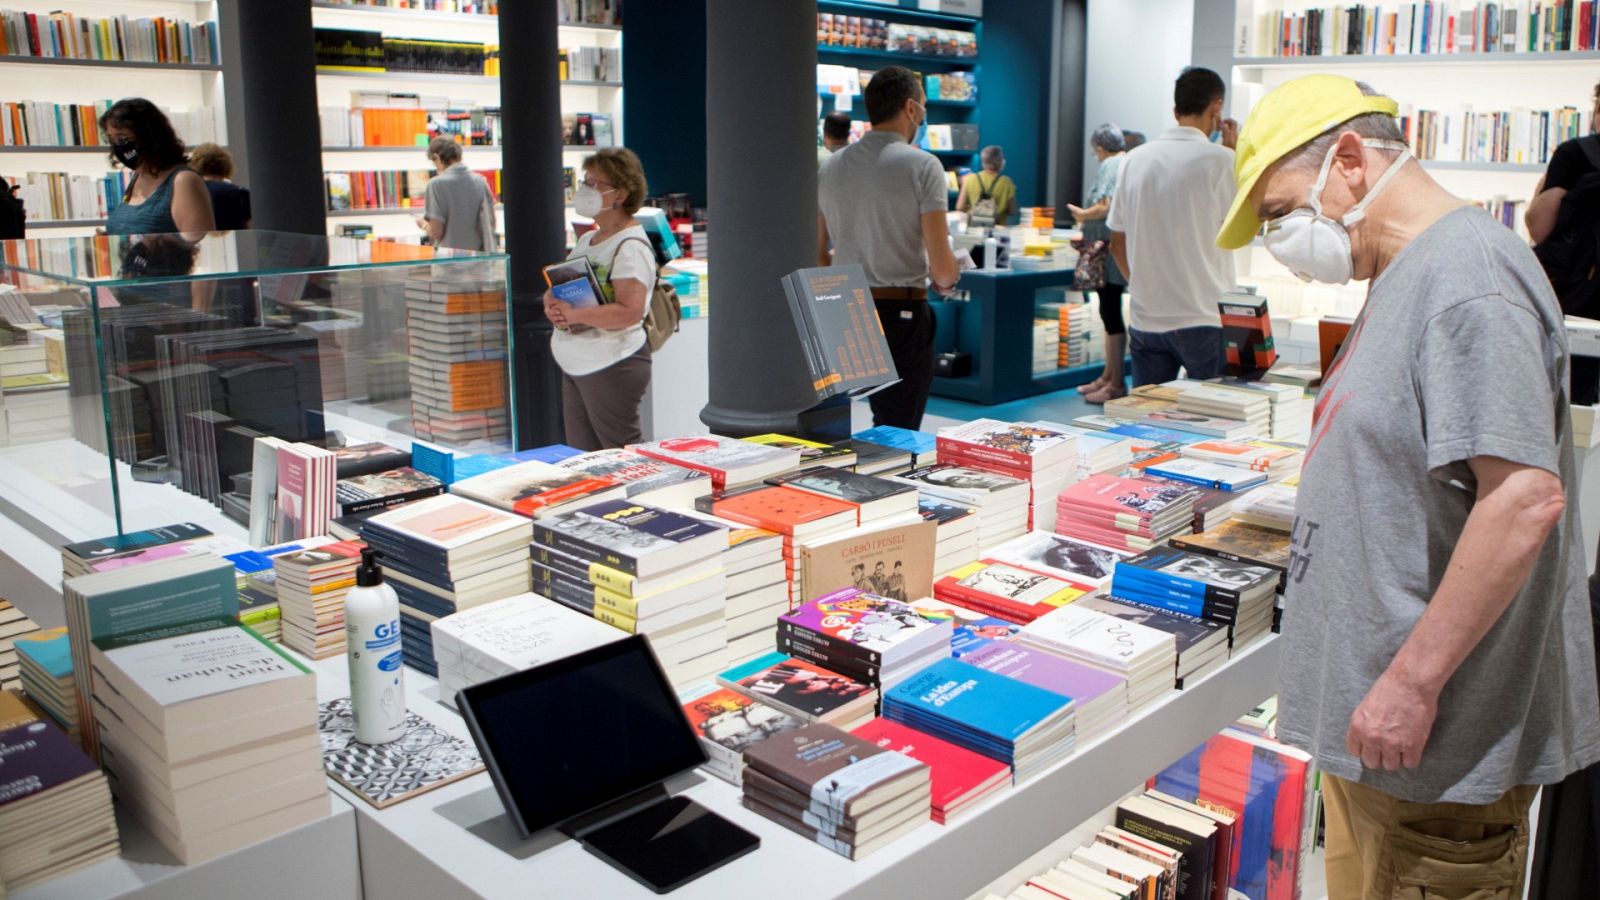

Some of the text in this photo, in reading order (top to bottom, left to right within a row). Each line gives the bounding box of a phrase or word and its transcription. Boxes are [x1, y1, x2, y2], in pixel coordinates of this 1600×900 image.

[166, 657, 274, 682] de Wuhan
[228, 664, 284, 680] Diari
